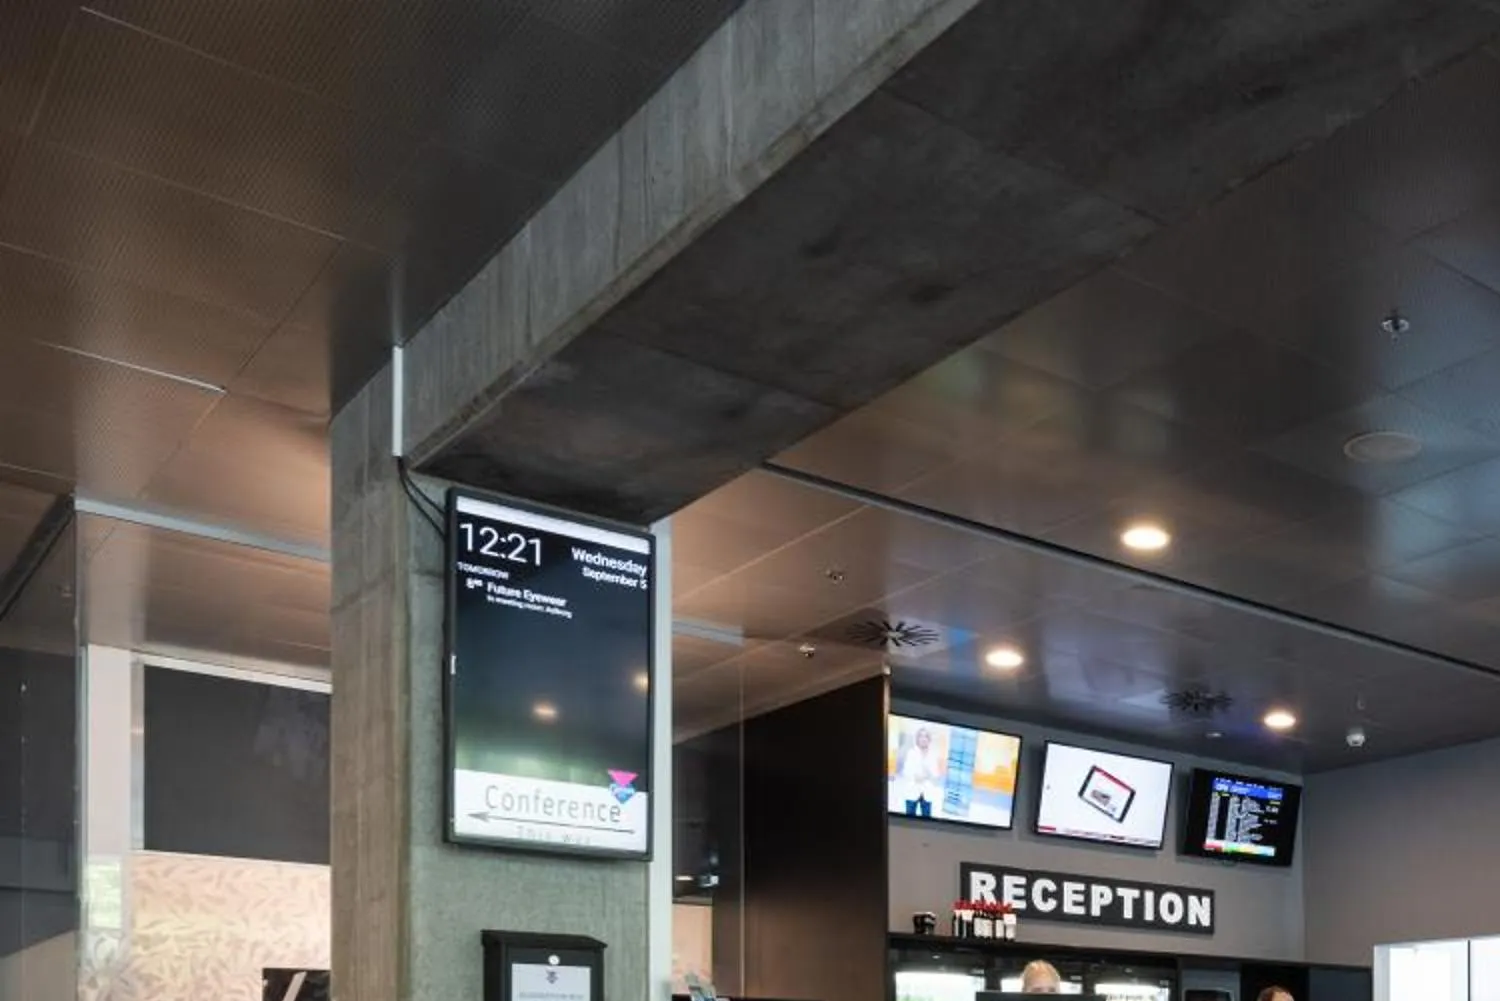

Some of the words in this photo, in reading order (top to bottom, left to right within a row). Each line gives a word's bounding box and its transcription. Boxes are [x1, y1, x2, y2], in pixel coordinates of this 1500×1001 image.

[459, 522, 541, 567] 12:21
[571, 547, 647, 578] Wednesday
[582, 565, 638, 588] September
[487, 582, 521, 599] Future
[485, 785, 621, 823] Conference
[969, 871, 1211, 927] RECEPTION
